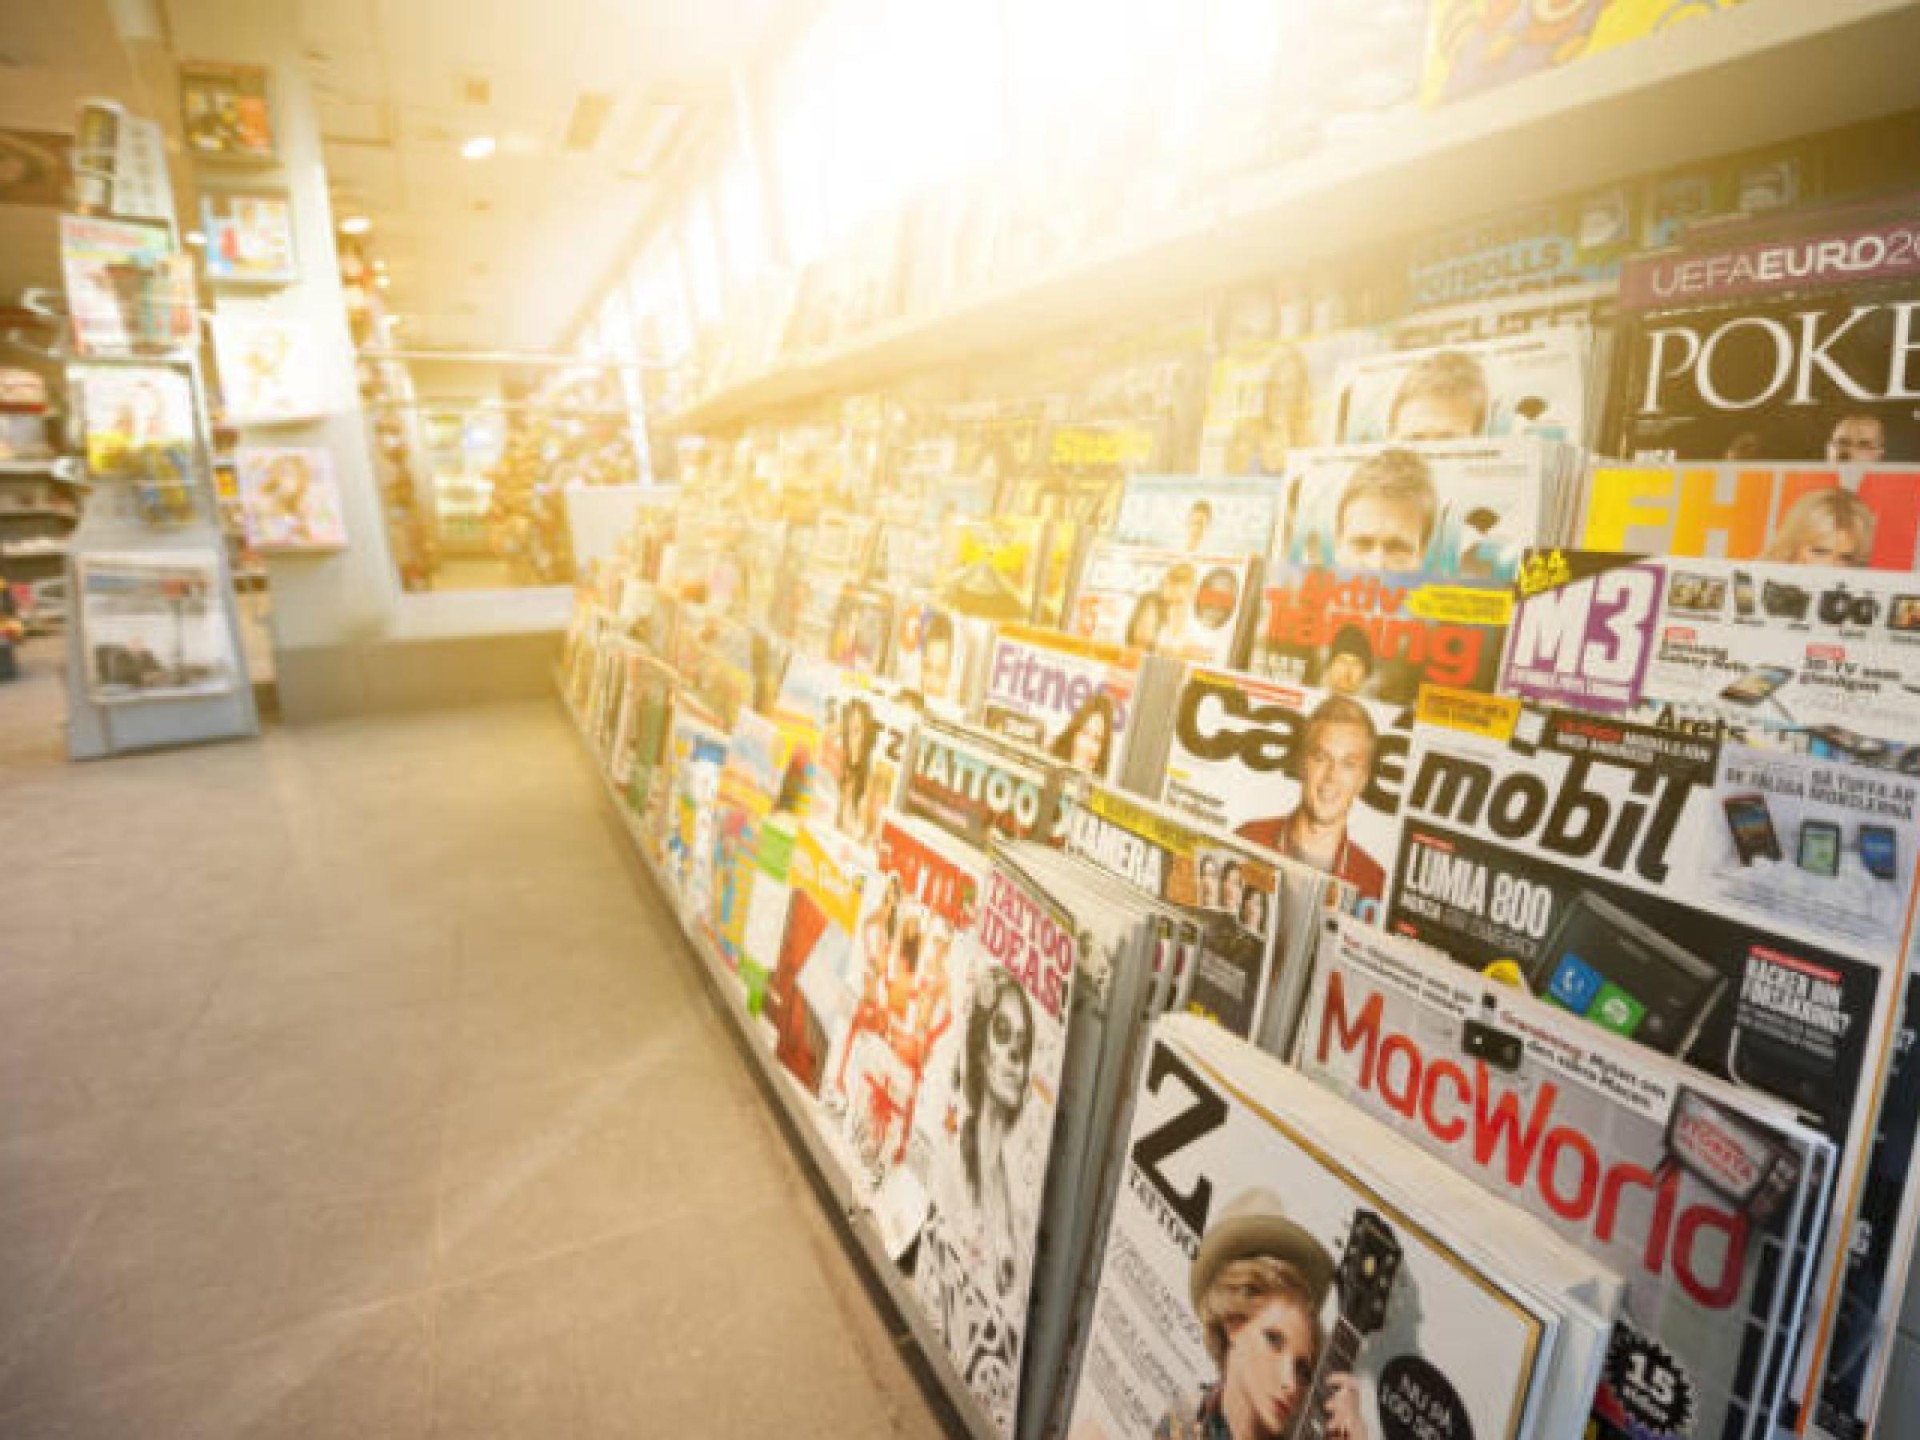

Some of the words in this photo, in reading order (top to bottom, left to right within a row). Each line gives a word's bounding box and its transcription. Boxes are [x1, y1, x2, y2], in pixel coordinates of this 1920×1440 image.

[1582, 468, 1917, 572] FHM
[1513, 568, 1658, 685] M3
[914, 733, 1041, 829] TATTOO
[1409, 751, 1697, 885] mobil
[991, 870, 1073, 977] TATTOO
[1405, 841, 1489, 917] LUMIA
[1490, 872, 1552, 940] 800
[979, 907, 1064, 1018] IDEAS
[1130, 1039, 1229, 1239] Z
[1315, 969, 1751, 1312] MacWorld
[1624, 1354, 1679, 1405] 15
